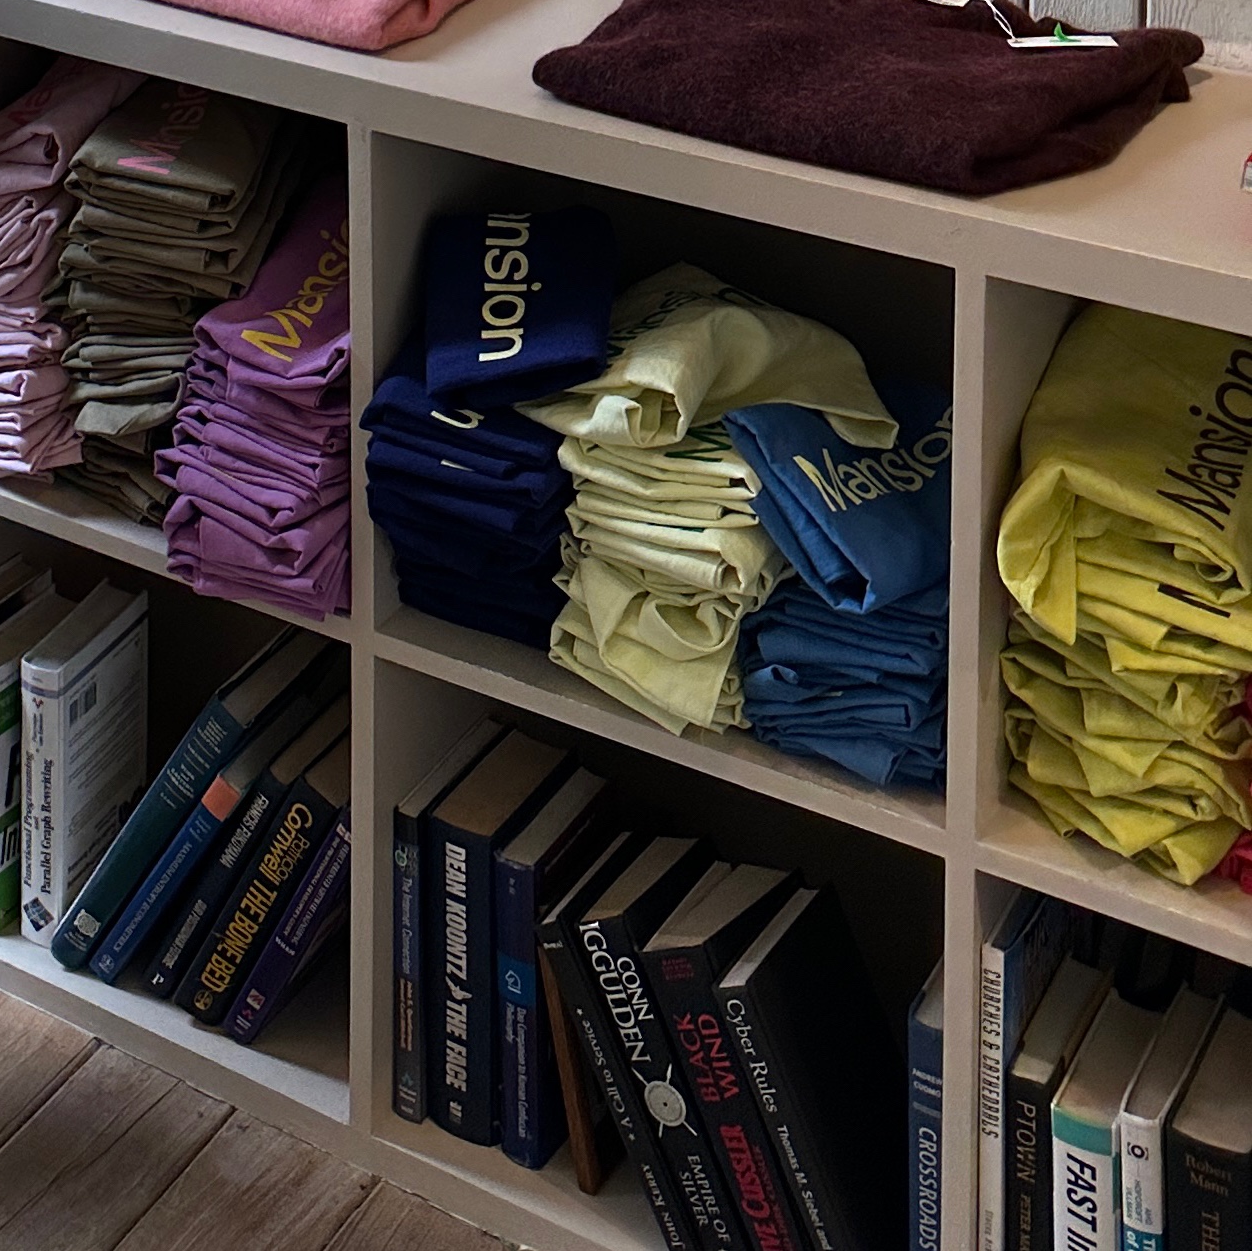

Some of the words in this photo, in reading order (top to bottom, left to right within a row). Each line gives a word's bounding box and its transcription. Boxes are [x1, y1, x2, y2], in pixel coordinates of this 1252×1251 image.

[478, 212, 543, 363] nsion
[23, 750, 33, 826] Programming
[40, 758, 53, 813] Rewriting
[240, 793, 270, 830] FRANCIS
[23, 829, 32, 888] Functional
[40, 816, 53, 848] Graph
[219, 824, 252, 869] FUKUYAMA
[258, 803, 313, 886] Cornwell
[273, 832, 310, 881] Patricia
[39, 850, 51, 894] Parallel
[445, 841, 467, 898] DEAN
[235, 879, 278, 923] THE
[402, 893, 413, 927] Internet
[216, 910, 259, 964] BONE
[401, 928, 413, 975] Connection
[445, 898, 468, 981] KOONTZ
[201, 952, 236, 993] BED
[578, 920, 652, 1062] IGGULDEN
[611, 956, 654, 1021] CONN
[982, 967, 1002, 1033] CHURCHES
[446, 1000, 468, 1040] THE
[582, 1020, 607, 1066] Service
[445, 1039, 467, 1092] FACE
[603, 1069, 614, 1083] to
[677, 1012, 721, 1102] BLACK
[697, 1014, 739, 1099] WIND
[606, 1086, 625, 1113] Call
[726, 999, 756, 1056] Cyber
[749, 1061, 778, 1112] Rules
[777, 1124, 800, 1170] Thomas
[801, 1190, 824, 1227] Siebel
[913, 1079, 942, 1098] CUOMO
[982, 1054, 1001, 1139] CATHEDRALS
[620, 1116, 633, 1128] A
[1015, 1099, 1036, 1183] PTOWN
[642, 1165, 666, 1206] KERRY
[680, 1171, 709, 1227] SILVER
[687, 1155, 720, 1214] EMPIRE
[713, 1219, 730, 1241] OF
[719, 1125, 779, 1219] CUSSLER
[918, 1126, 938, 1251] CROSSROADS
[1066, 1152, 1097, 1233] FAST
[663, 1212, 686, 1249] JOHN
